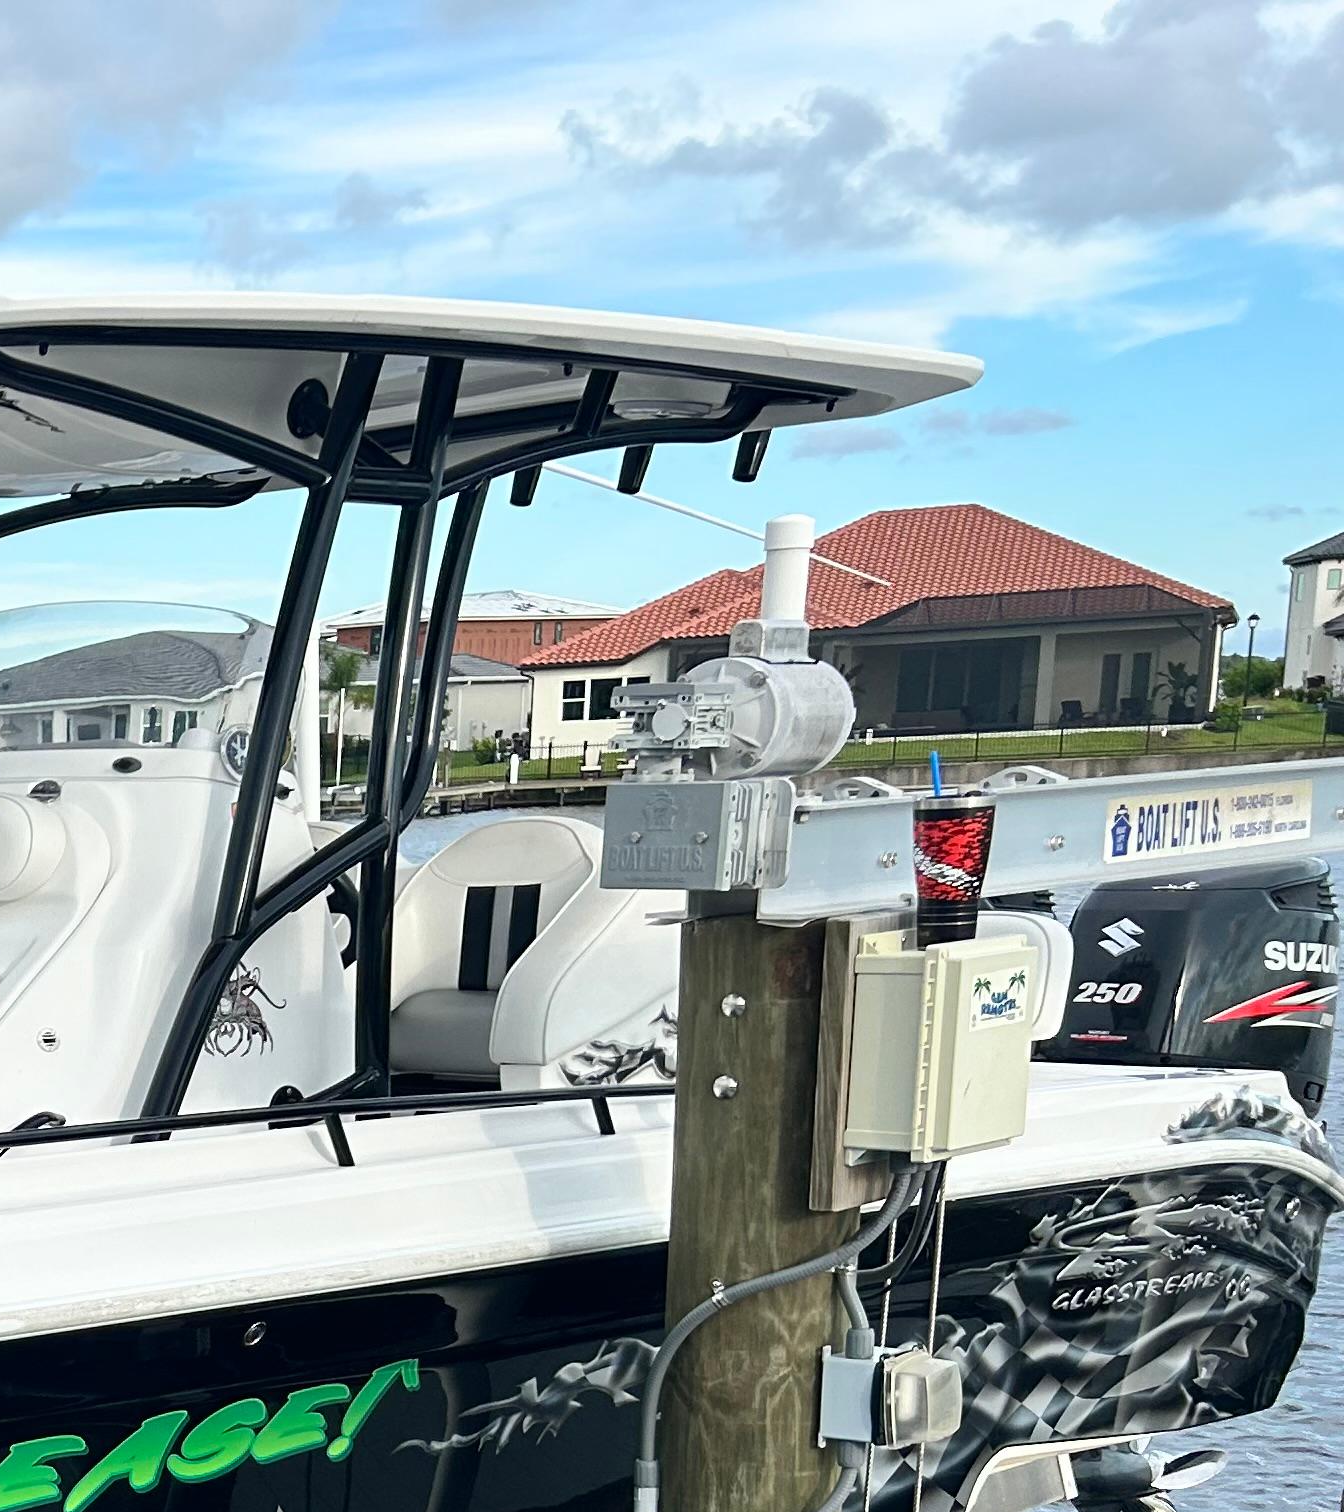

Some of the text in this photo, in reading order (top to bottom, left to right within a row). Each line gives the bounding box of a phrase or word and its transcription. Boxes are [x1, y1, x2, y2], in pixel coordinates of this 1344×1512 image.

[1136, 803, 1169, 852] BOAT
[1171, 801, 1198, 847] LIFT
[1200, 798, 1222, 845] U.S.
[1264, 940, 1337, 973] SUZU
[1073, 982, 1142, 1004] 250
[1051, 1271, 1217, 1311] GLASSTREAM
